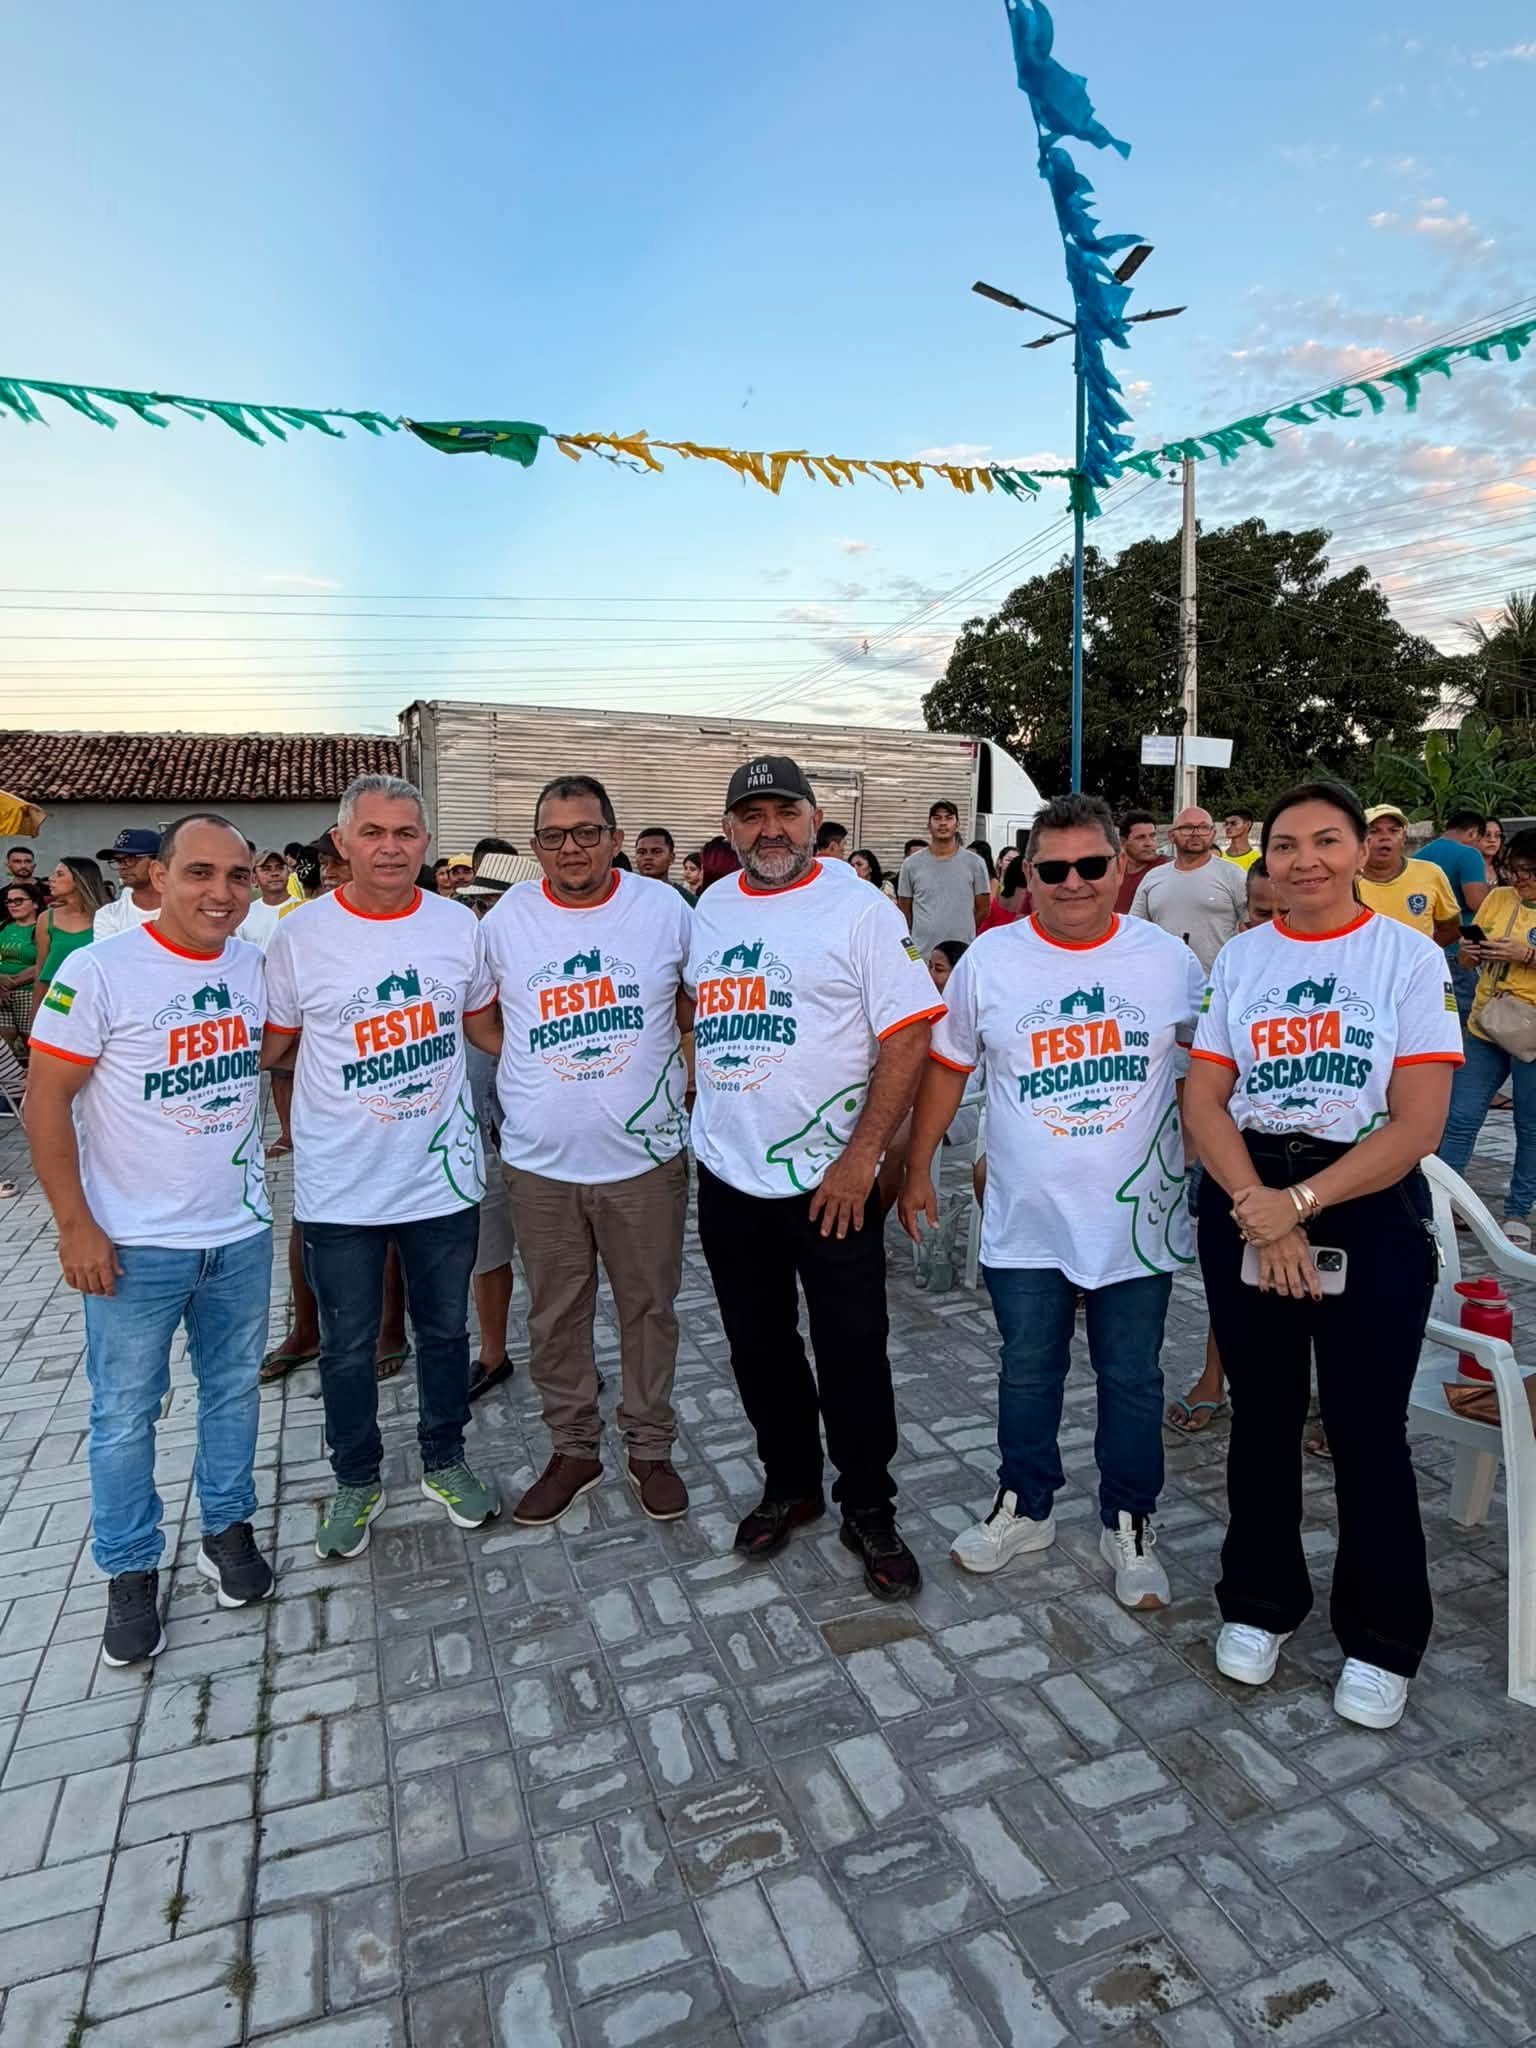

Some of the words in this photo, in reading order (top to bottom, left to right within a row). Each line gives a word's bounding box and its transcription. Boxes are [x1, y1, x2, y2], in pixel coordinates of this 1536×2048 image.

[747, 773, 774, 789] PARD
[750, 763, 768, 775] LEO
[539, 976, 617, 1021] FESTA
[618, 984, 640, 999] DOS
[698, 976, 767, 1019] FESTA
[769, 990, 793, 1009] DOS
[168, 1015, 249, 1067] FESTA
[250, 1026, 262, 1041] DO
[354, 1001, 438, 1057] FESTA
[439, 1010, 455, 1027] DOS
[529, 1005, 645, 1054] PESCADORES
[694, 1013, 797, 1049] ESCADORES
[1031, 1019, 1122, 1068] FESTA
[1125, 1031, 1150, 1047] DOS
[1251, 1010, 1341, 1061] FESTA
[1344, 1025, 1375, 1050] DOS
[144, 1050, 260, 1101] PESCADORE
[341, 1032, 456, 1091] PESCADORES
[576, 1070, 605, 1081] 2026
[1017, 1055, 1150, 1103] PESCADORES
[715, 1081, 740, 1092] 2026
[203, 1122, 233, 1135] 2026
[397, 1107, 428, 1120] 2026
[1071, 1125, 1103, 1137] 2026
